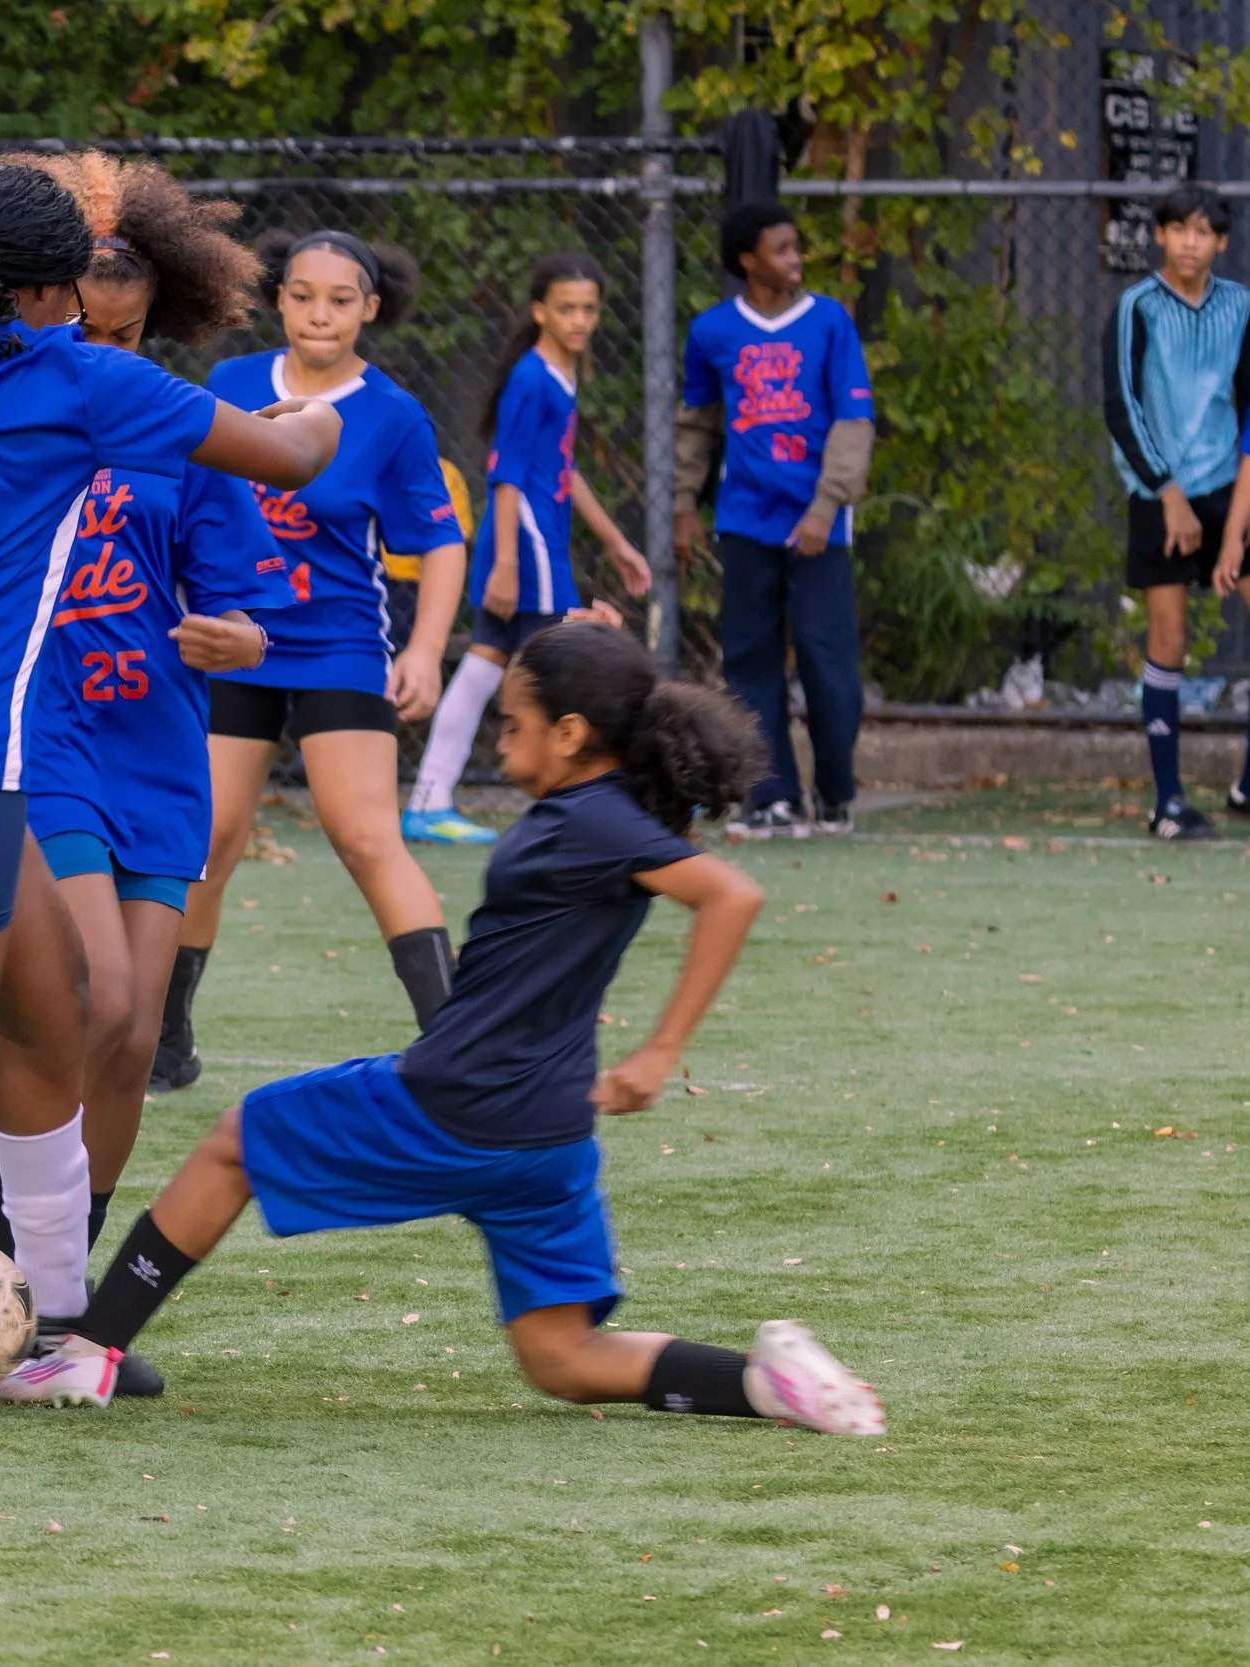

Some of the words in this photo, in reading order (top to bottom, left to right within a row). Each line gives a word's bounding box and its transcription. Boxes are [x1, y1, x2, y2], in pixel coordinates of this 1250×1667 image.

[77, 484, 134, 538] st
[56, 541, 148, 624] de
[82, 650, 149, 701] 25
